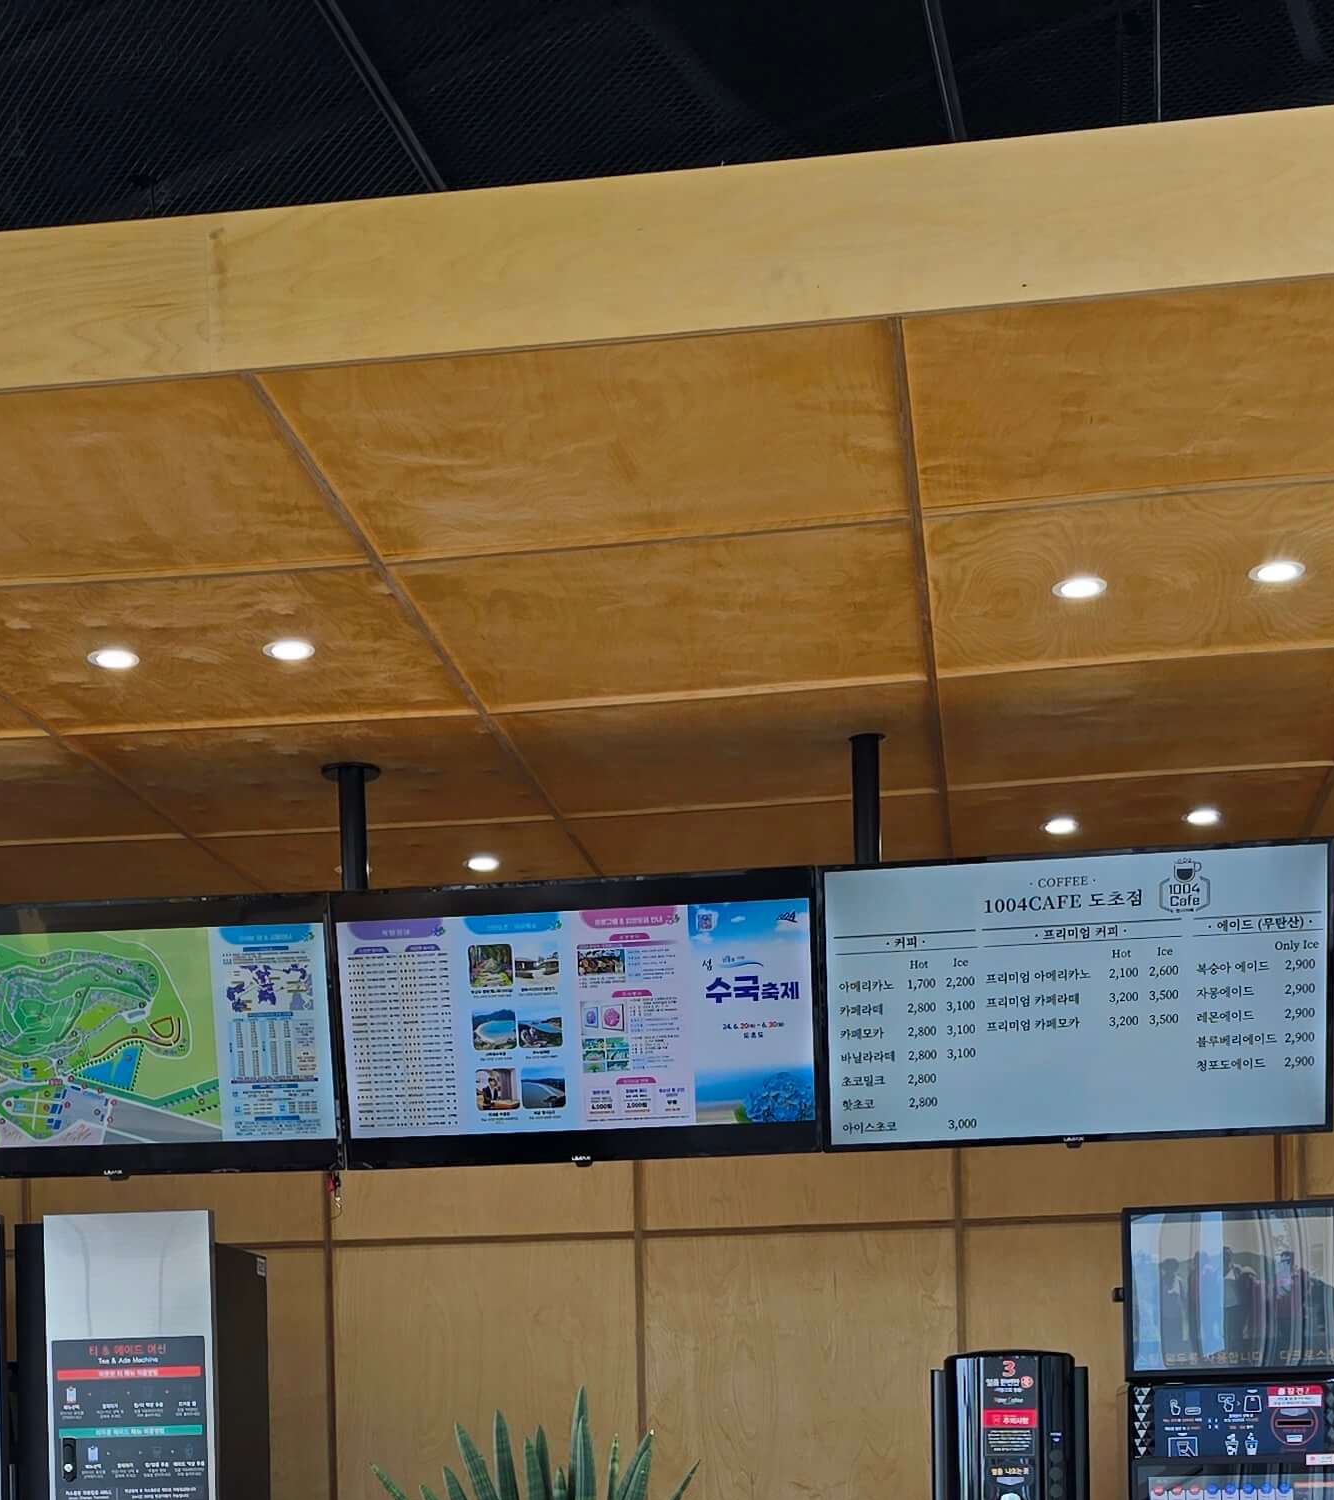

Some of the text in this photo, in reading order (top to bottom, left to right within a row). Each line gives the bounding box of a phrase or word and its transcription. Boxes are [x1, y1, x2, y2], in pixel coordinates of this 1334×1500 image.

[1038, 876, 1088, 888] COFFEE
[1169, 884, 1200, 895] 1004
[984, 889, 1142, 913] 1004CAFE 도초점
[1170, 895, 1200, 907] Cafe
[1217, 916, 1304, 931] 에이드 (무탄산)
[1043, 925, 1118, 940] 프리미엄 커피
[894, 936, 917, 947] 커피
[1275, 940, 1319, 951] Only Ice
[1112, 947, 1173, 958] Hot Ice
[910, 958, 968, 969] Hot Ice
[1196, 959, 1315, 975] 복숭아 에이드 2,900
[986, 965, 1179, 984] 프리미엄 아메리카노 2,100 2,600
[706, 976, 799, 1003] 수국축제
[839, 976, 975, 992] 아메리카노 1,700 2,200
[1196, 983, 1315, 1000] 자몽에이드 2,900
[987, 995, 1030, 1008] 프리미엄
[1109, 991, 1139, 1003] 3,200
[1149, 989, 1179, 1001] 3,500
[908, 1003, 936, 1014] 2,800
[946, 1001, 975, 1012] 3,100
[987, 1013, 1179, 1032] 프리미엄 카페모카 3,200 3,500
[1196, 1008, 1315, 1023] 레몬에이드 2,900
[840, 1025, 976, 1040] 카페모카 2,800 3,100
[1197, 1032, 1314, 1048] 블루베리에이드 2,900
[908, 1050, 937, 1061] 2,800
[947, 1048, 976, 1059] 3,100
[1197, 1056, 1314, 1072] 청포도에이드 2,900
[842, 1074, 936, 1086] 초코밀크 2,800
[909, 1097, 938, 1109] 2,800
[843, 1119, 977, 1134] 아이스초코 3,000
[1003, 1360, 1016, 1377] 3
